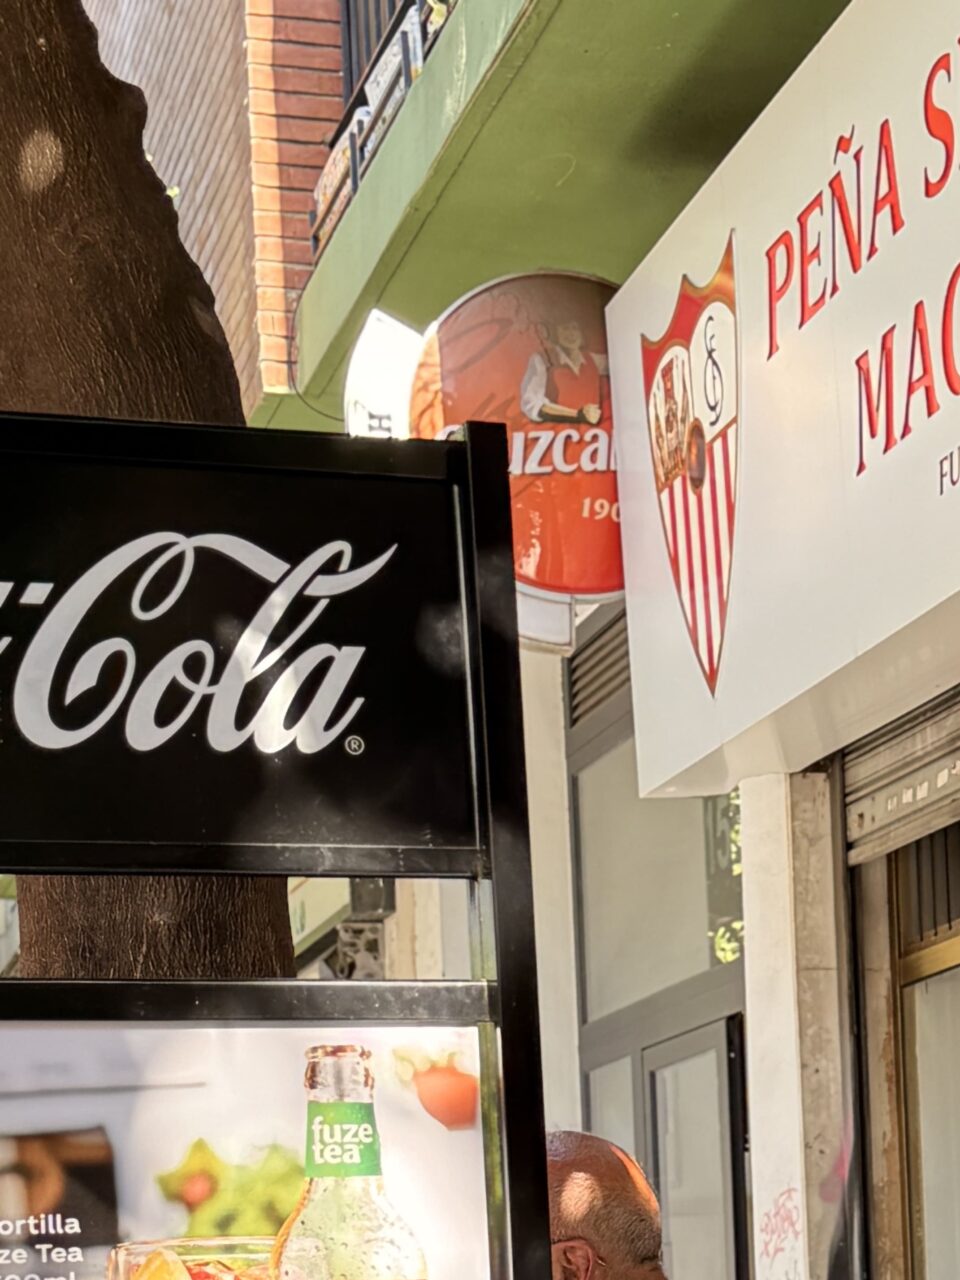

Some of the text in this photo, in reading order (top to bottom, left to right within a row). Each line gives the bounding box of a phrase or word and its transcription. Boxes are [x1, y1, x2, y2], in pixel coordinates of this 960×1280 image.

[766, 118, 905, 361] PEÑA
[311, 1115, 374, 1144] fuze
[312, 1143, 362, 1165] tea
[0, 1213, 81, 1235] ortilla
[34, 1243, 84, 1263] Tea
